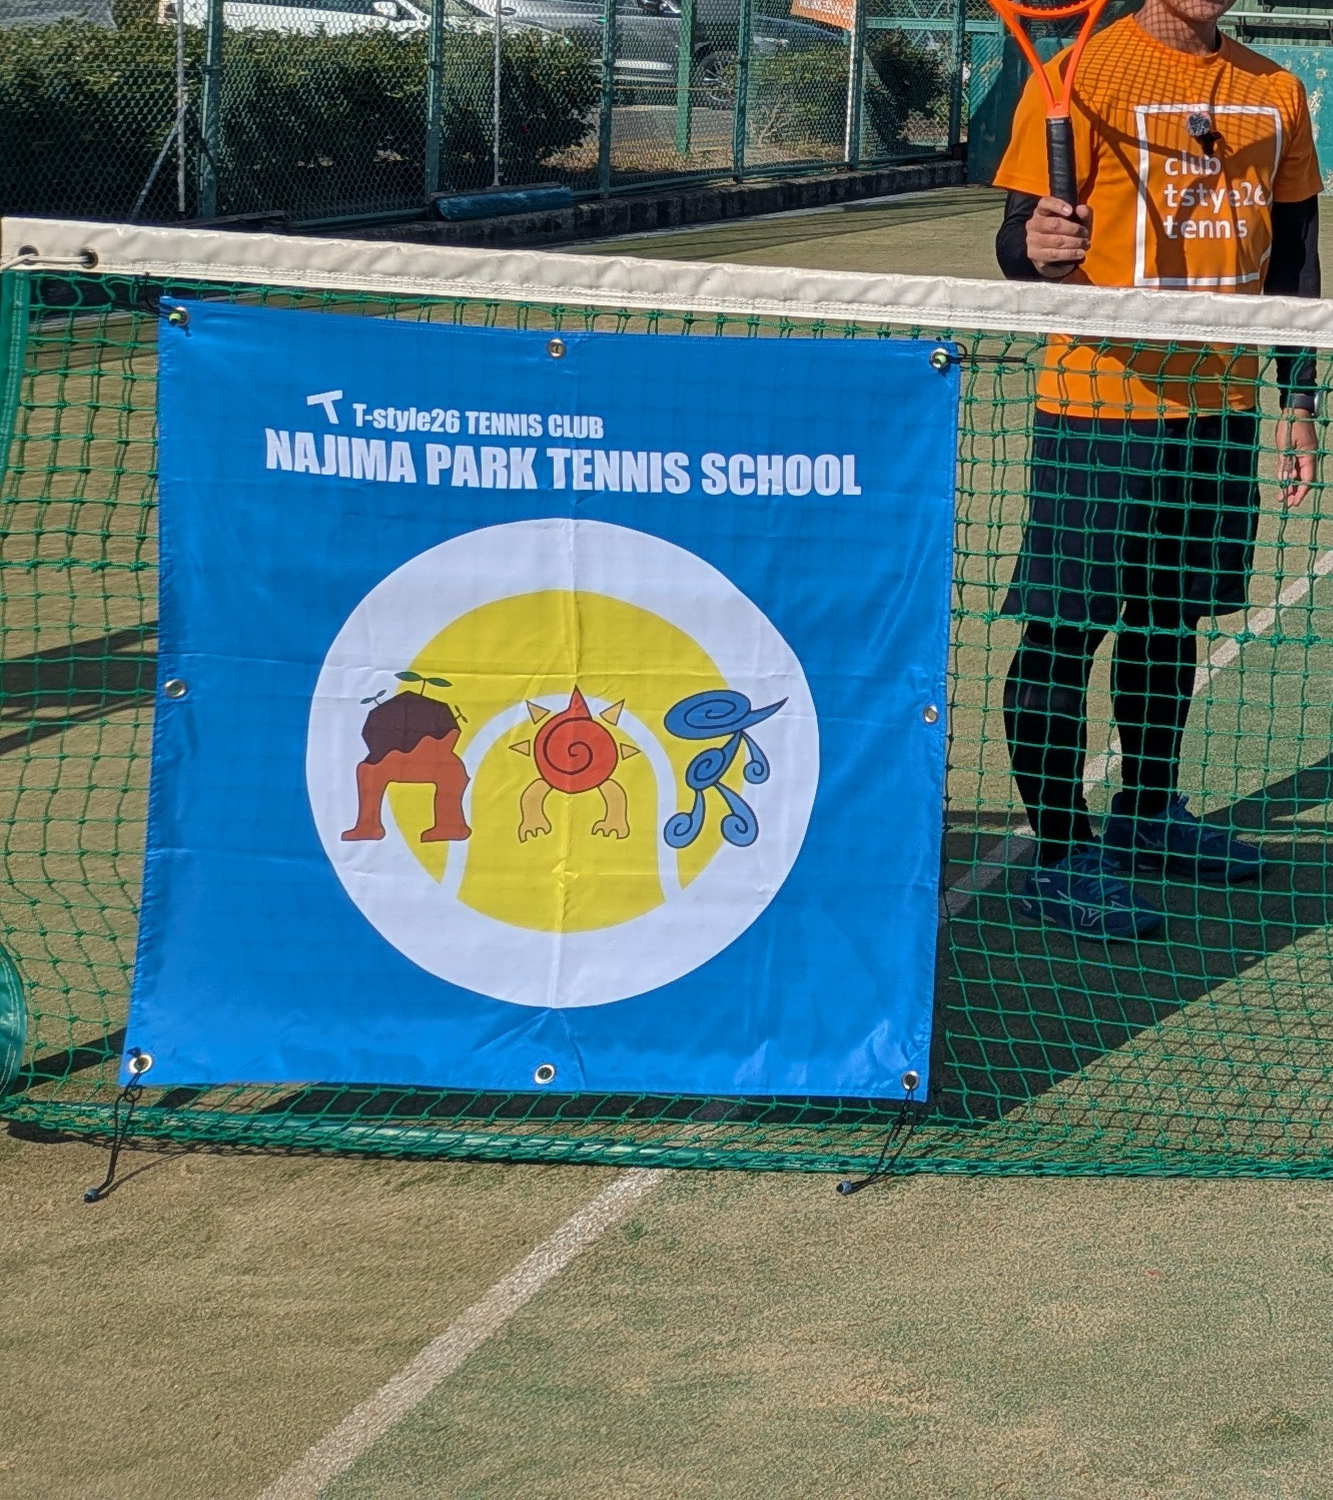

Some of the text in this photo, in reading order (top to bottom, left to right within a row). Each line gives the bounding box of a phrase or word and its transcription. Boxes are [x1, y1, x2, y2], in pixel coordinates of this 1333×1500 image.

[1164, 150, 1221, 176] club
[1163, 181, 1273, 214] tstye26
[1163, 215, 1248, 239] tenns
[306, 390, 343, 425] T
[353, 403, 604, 439] T-style26 TENNIS CLUB
[265, 428, 862, 496] NAJIMA PARK TENNIS SCHOOL
